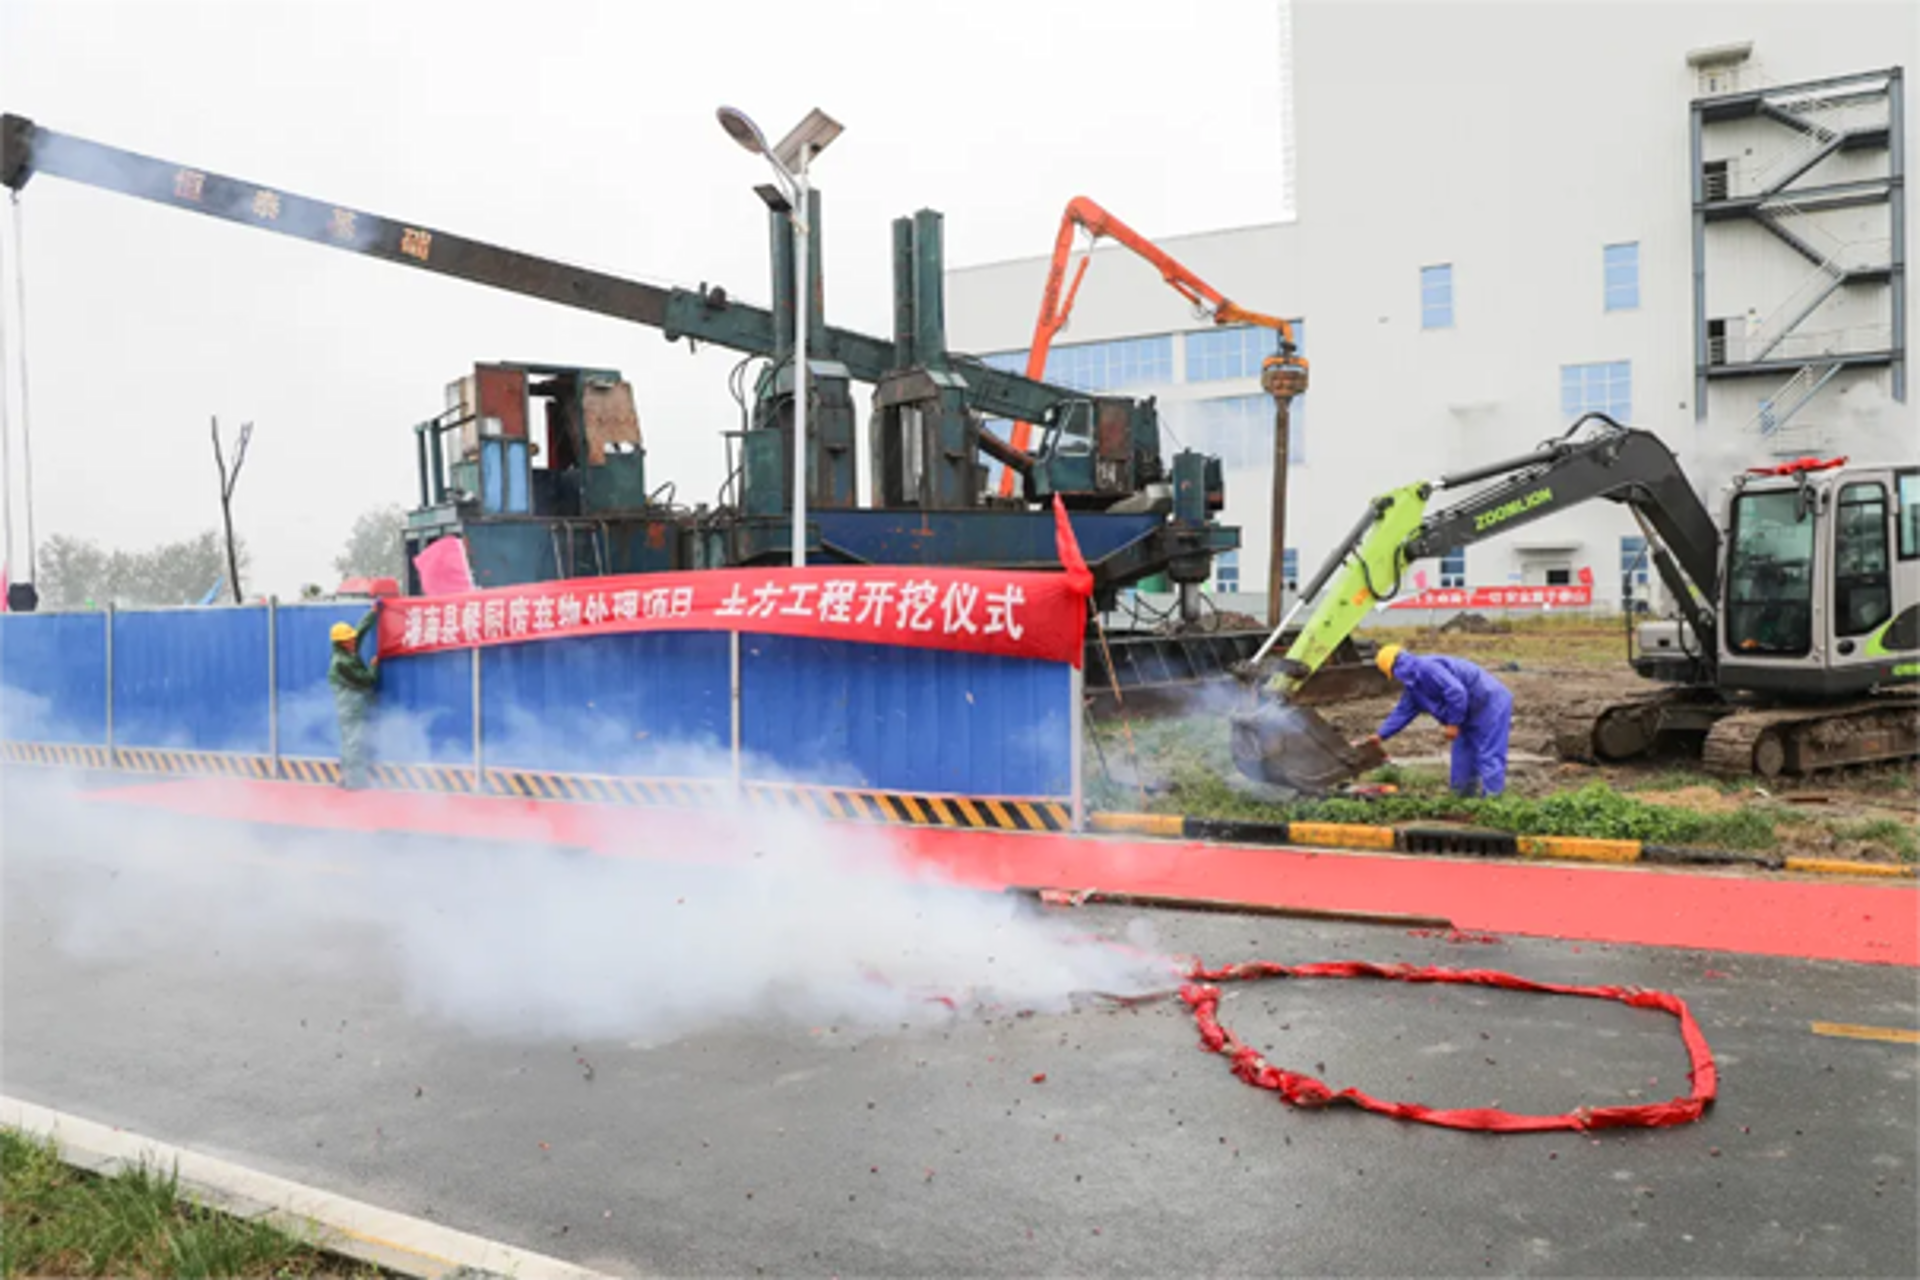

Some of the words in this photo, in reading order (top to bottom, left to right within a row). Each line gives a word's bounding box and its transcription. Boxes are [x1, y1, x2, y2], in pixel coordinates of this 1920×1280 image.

[1474, 486, 1553, 531] ZOOMLION
[714, 579, 1025, 640] 土方工程开挖仪式
